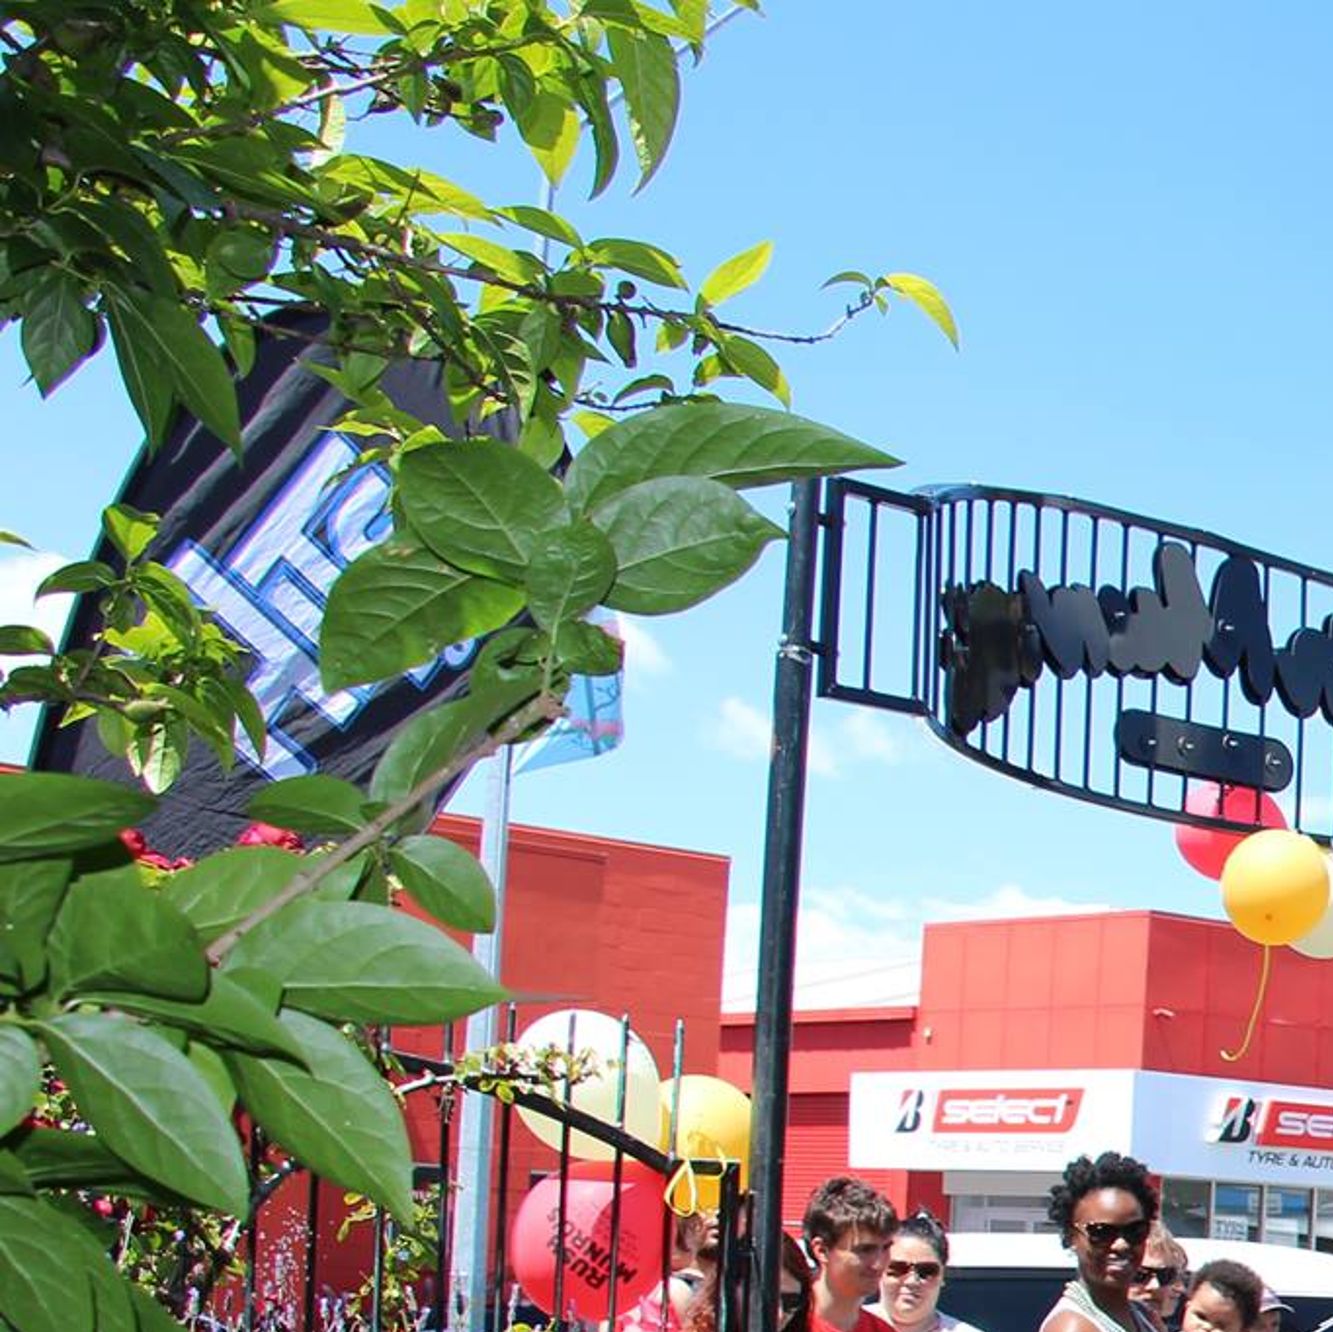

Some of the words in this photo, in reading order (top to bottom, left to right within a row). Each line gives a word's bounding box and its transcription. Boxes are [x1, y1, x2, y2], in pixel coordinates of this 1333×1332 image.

[940, 1093, 1069, 1125] select
[1248, 1151, 1286, 1167] TYRE
[1287, 1153, 1299, 1168] &
